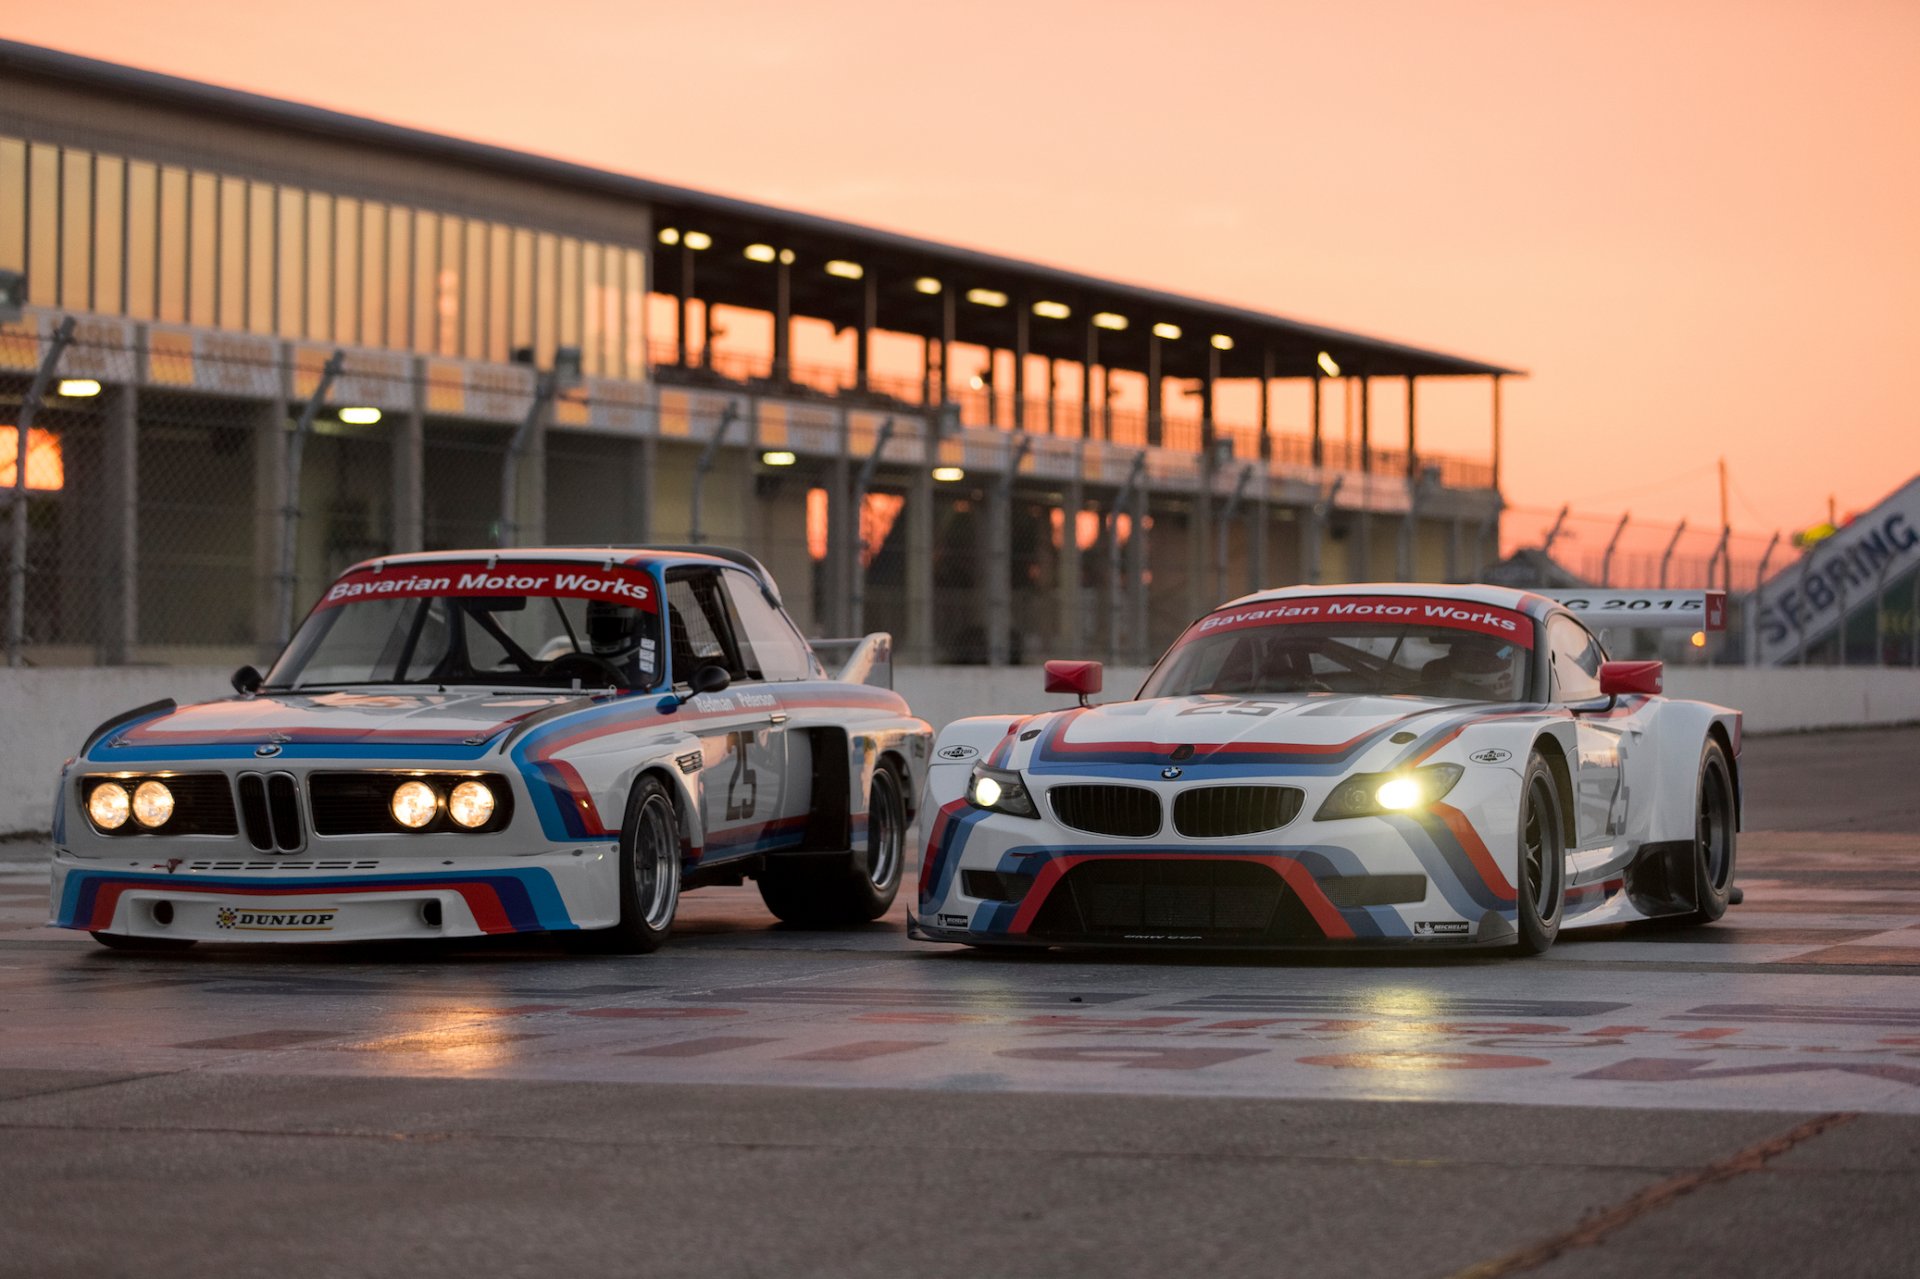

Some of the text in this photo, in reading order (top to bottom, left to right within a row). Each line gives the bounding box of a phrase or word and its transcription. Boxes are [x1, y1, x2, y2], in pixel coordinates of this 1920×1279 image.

[327, 574, 648, 601] Bavarian Motor Works
[1759, 513, 1919, 644] SEBRING
[1200, 603, 1516, 632] Bavarian Motor Works
[1601, 599, 1703, 611] 2015
[1176, 700, 1290, 717] 25
[726, 731, 757, 821] 25
[240, 914, 334, 926] DUNLOP
